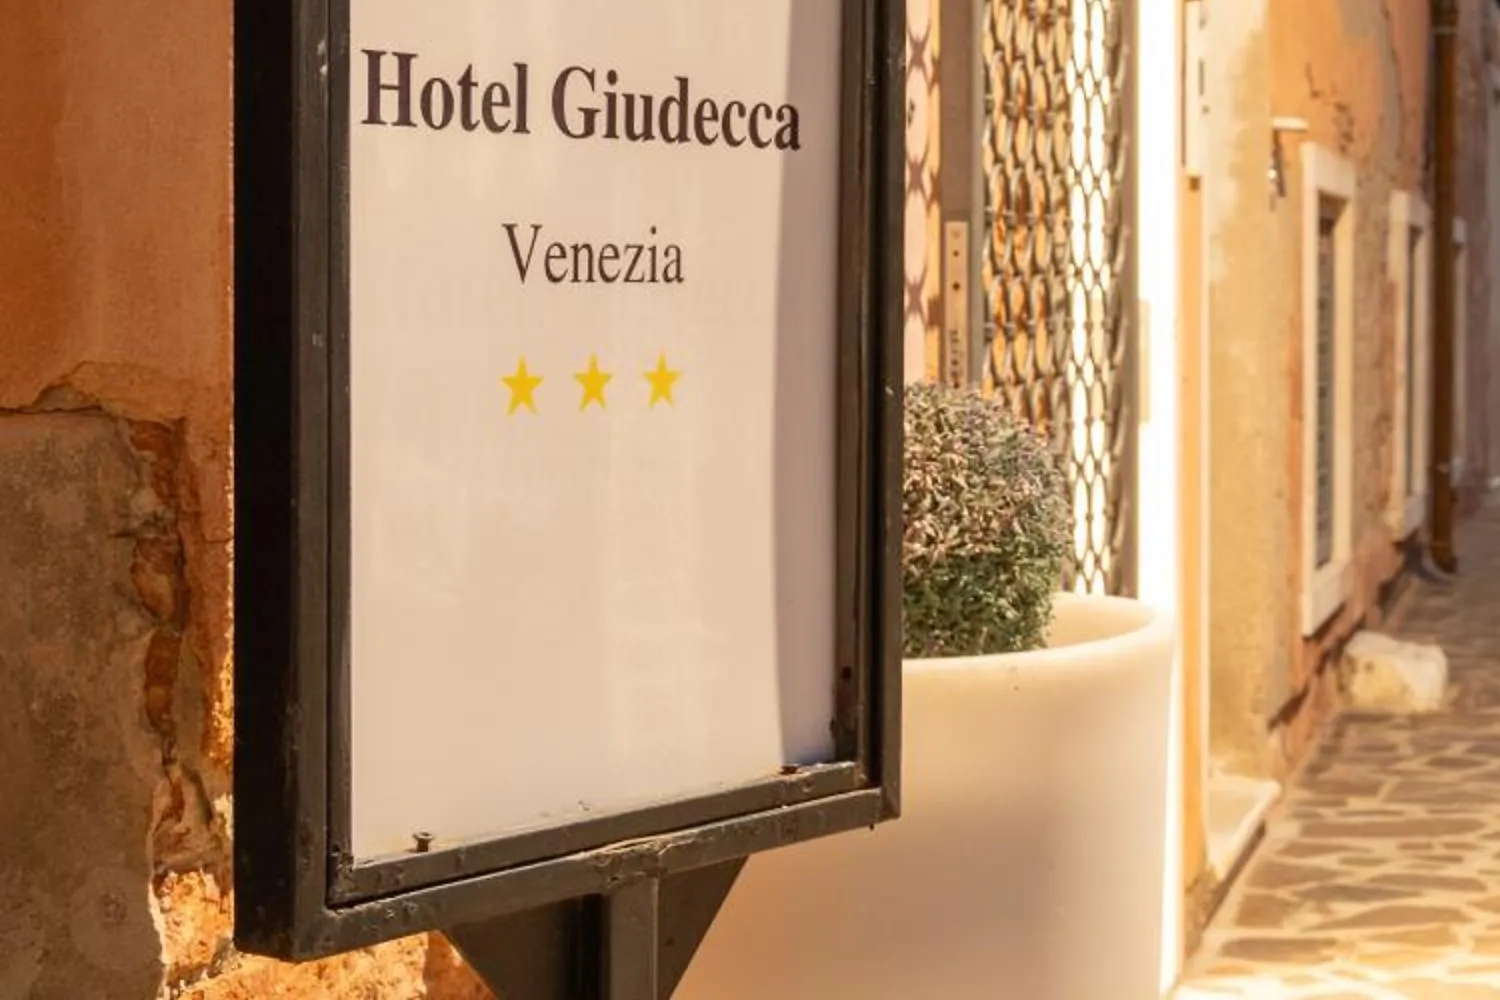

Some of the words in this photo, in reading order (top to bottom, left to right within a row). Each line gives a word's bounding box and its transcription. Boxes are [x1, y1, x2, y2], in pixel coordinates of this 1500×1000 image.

[360, 49, 531, 135] Hotel
[550, 65, 802, 152] Giudecca
[502, 223, 684, 285] Venezia
